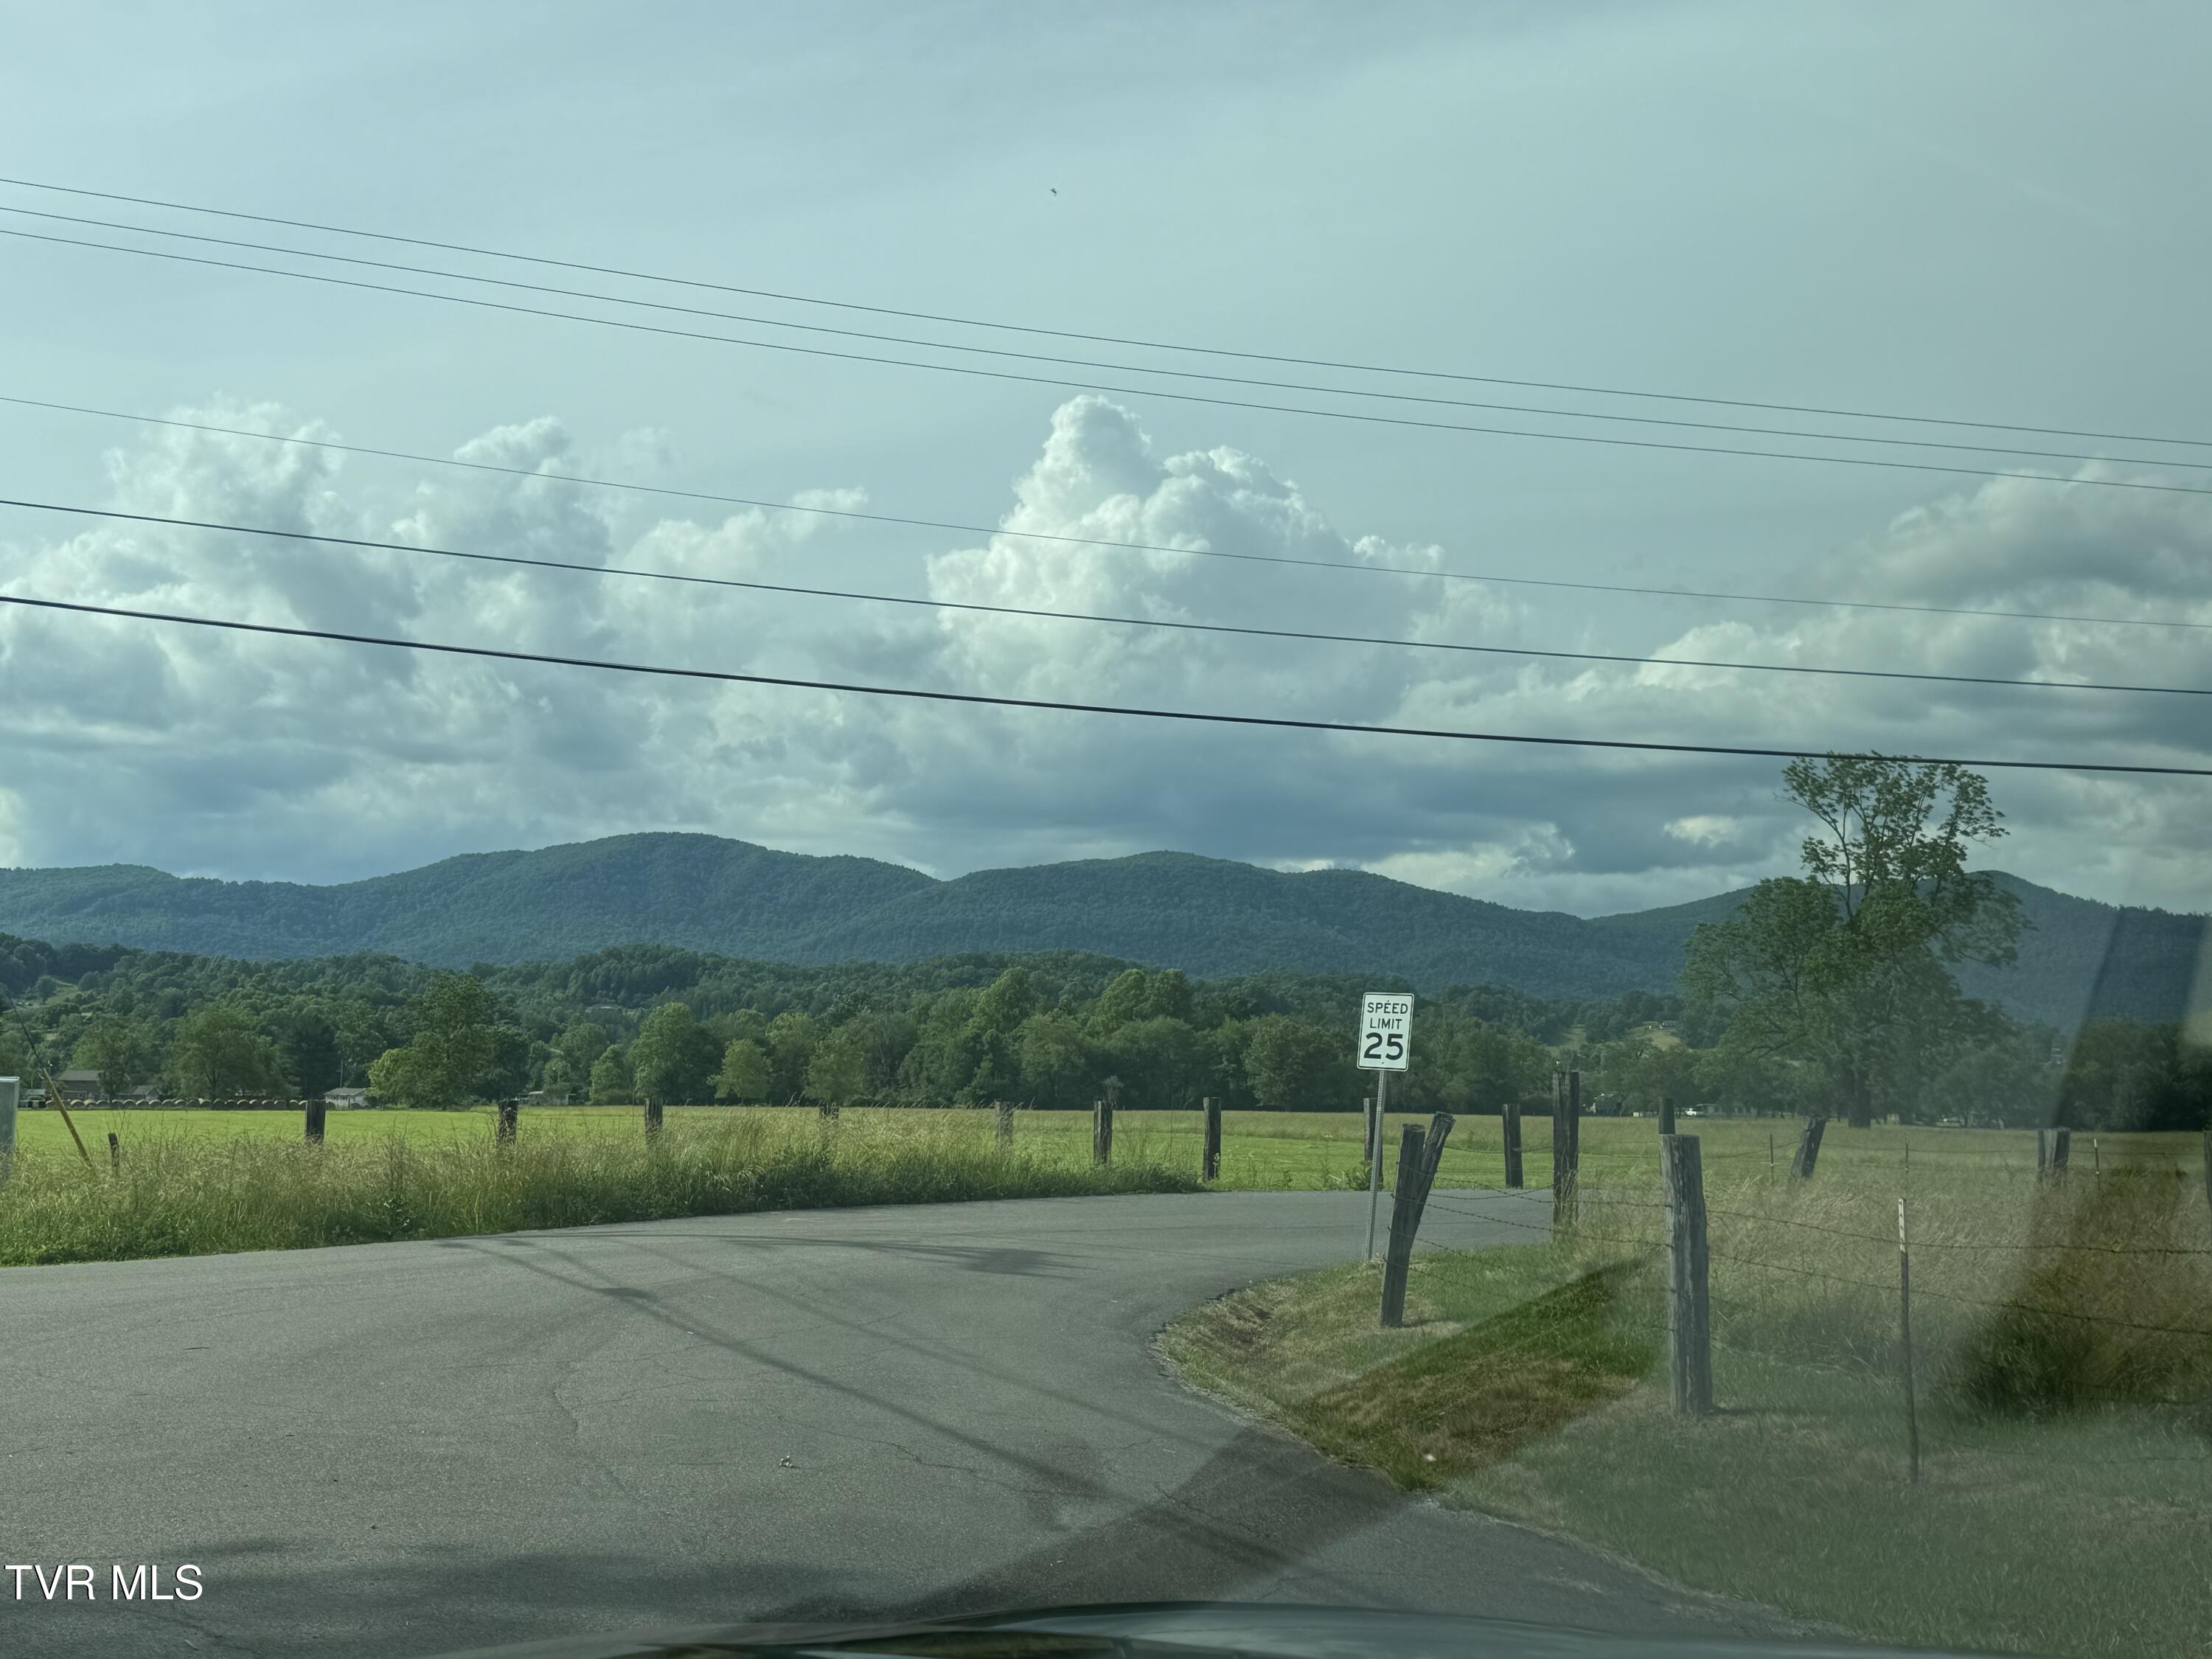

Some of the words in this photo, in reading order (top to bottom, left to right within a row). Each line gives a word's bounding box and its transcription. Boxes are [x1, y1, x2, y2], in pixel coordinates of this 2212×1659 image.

[1367, 1002, 1408, 1014] SPEED
[1370, 1018, 1402, 1029] LIMIT
[1363, 1032, 1403, 1060] 25
